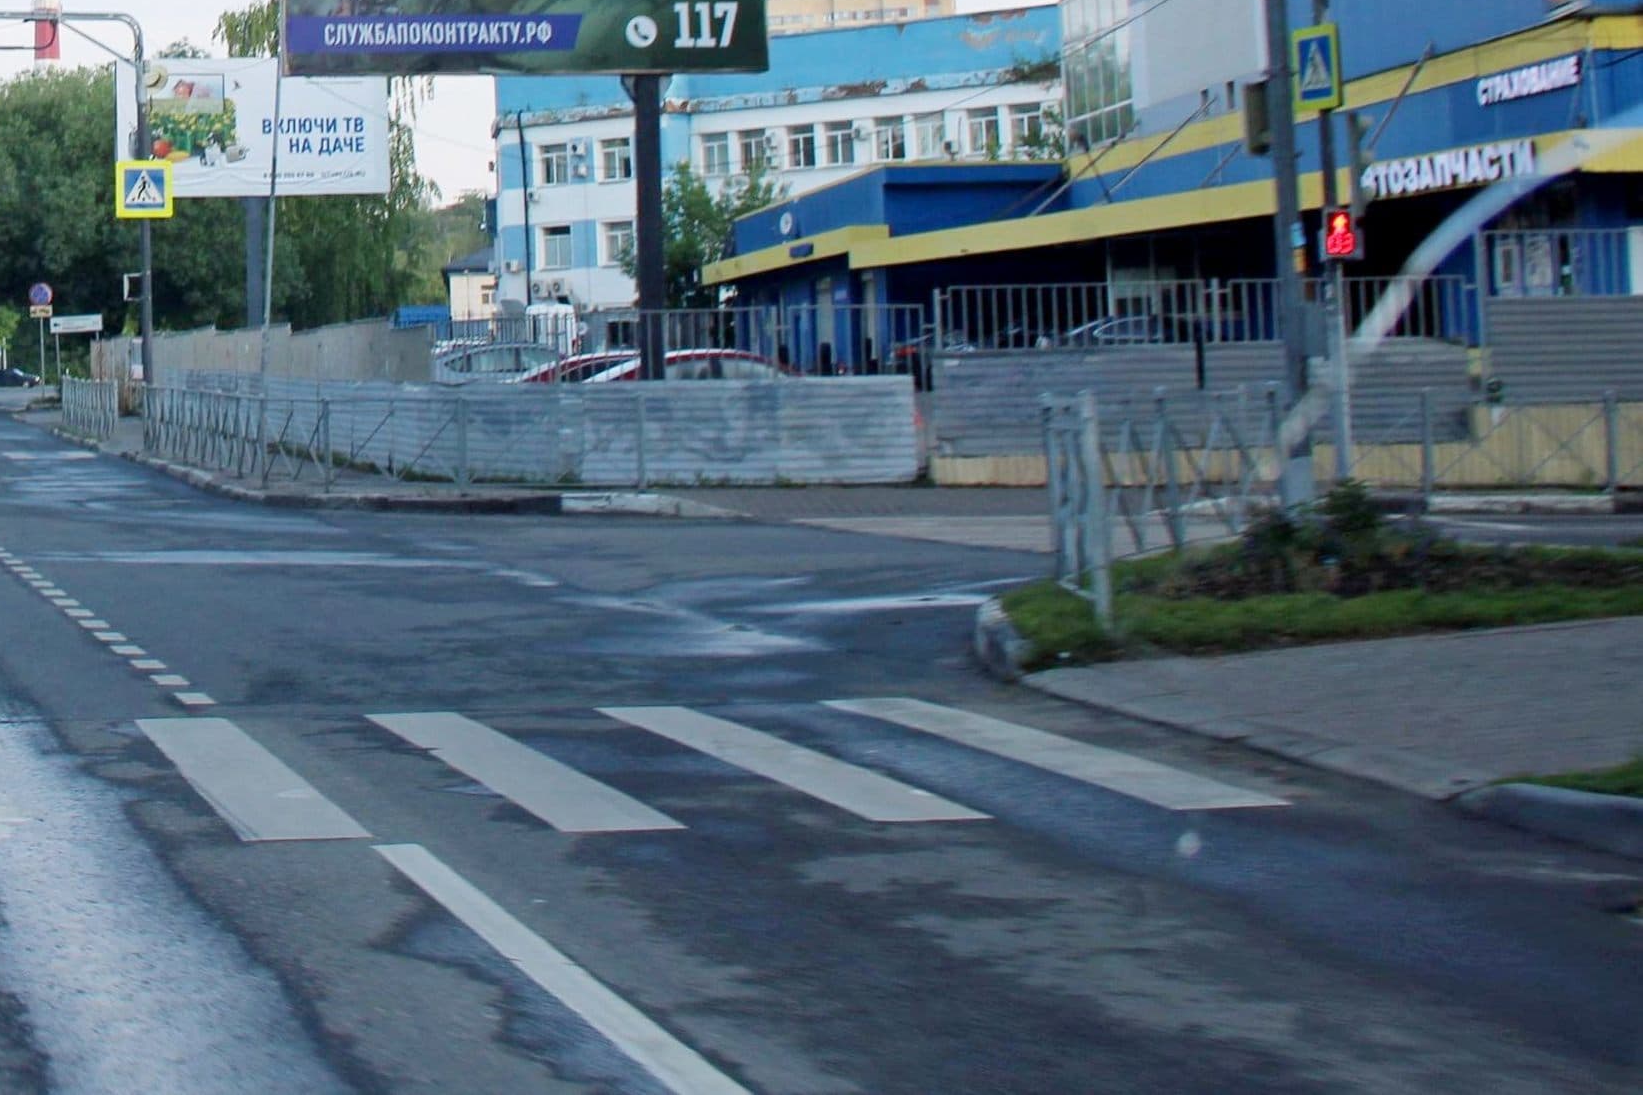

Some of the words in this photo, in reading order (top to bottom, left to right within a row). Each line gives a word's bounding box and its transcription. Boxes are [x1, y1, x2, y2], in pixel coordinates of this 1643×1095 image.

[323, 20, 553, 48] СЛУЖБАПОКОНТРАКТУ.РФ
[673, 1, 739, 49] 117
[1476, 55, 1581, 106] СТРАХОВАНИЕ
[345, 116, 364, 133] ТВ
[289, 136, 312, 153] НА
[318, 135, 365, 156] ДАЧЕ
[1361, 139, 1535, 198] ТОЗАПЧАСТИ
